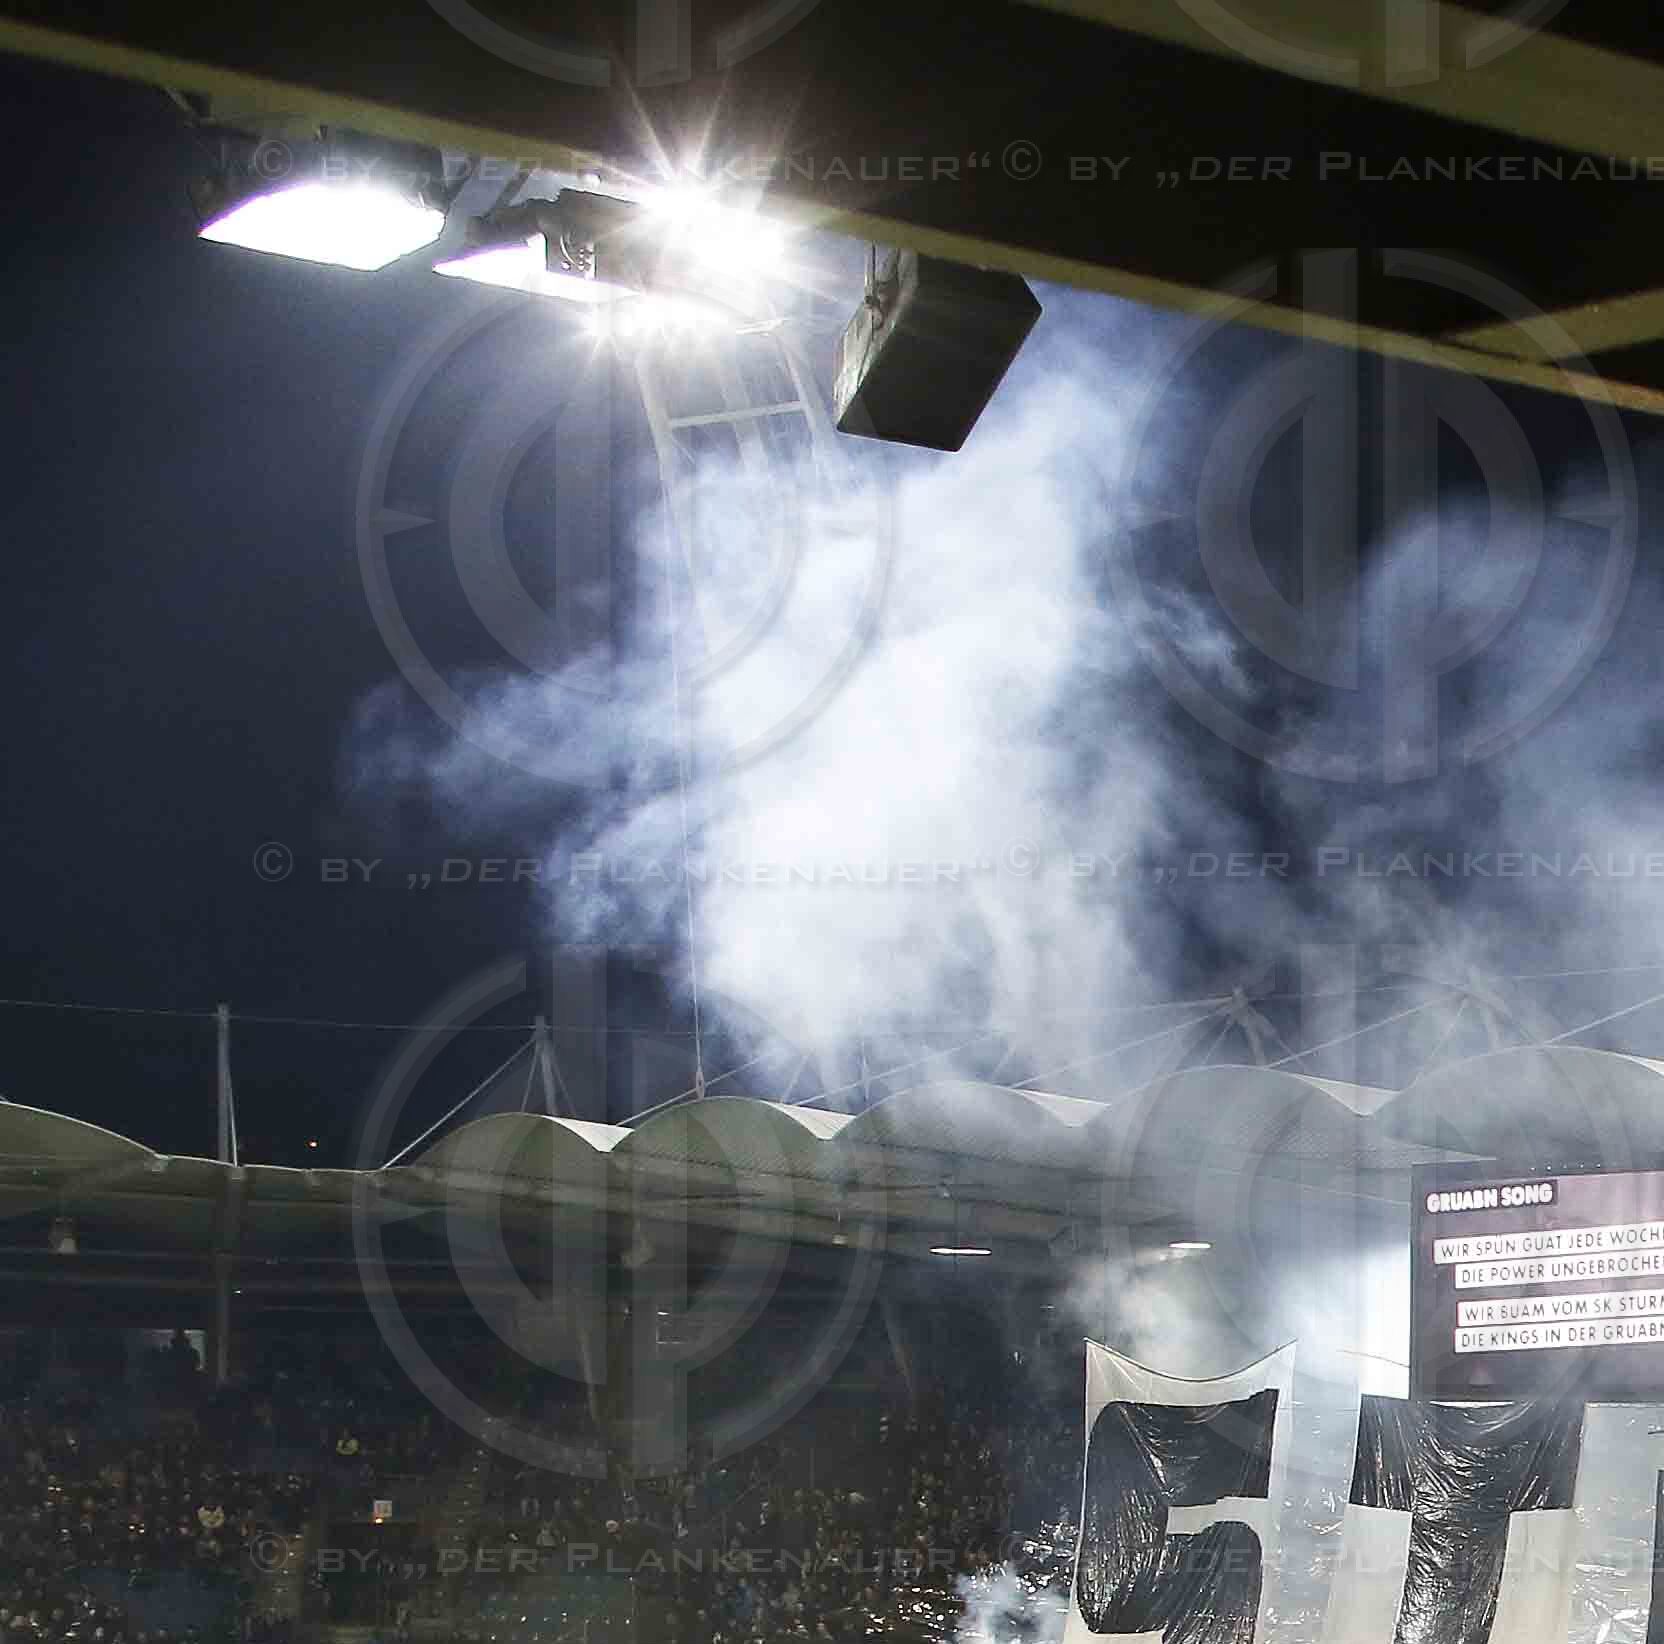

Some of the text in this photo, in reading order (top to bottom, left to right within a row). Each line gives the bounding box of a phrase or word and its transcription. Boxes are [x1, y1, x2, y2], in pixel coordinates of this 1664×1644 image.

[1427, 1182, 1553, 1214] GRUABN SONG
[1441, 1242, 1470, 1258] WIR
[1523, 1235, 1563, 1253] GUAT
[1569, 1231, 1603, 1249] JEDE
[1461, 1268, 1484, 1283] DIE
[1491, 1263, 1545, 1281] POWER
[1465, 1305, 1494, 1321] WIR
[1500, 1301, 1545, 1319] BUAM
[1552, 1298, 1588, 1316] VOM
[1594, 1296, 1613, 1312] SK
[1461, 1331, 1484, 1348] DIE
[1490, 1328, 1538, 1345] KINGS
[1545, 1327, 1561, 1342] IN
[1568, 1325, 1596, 1341] DER
